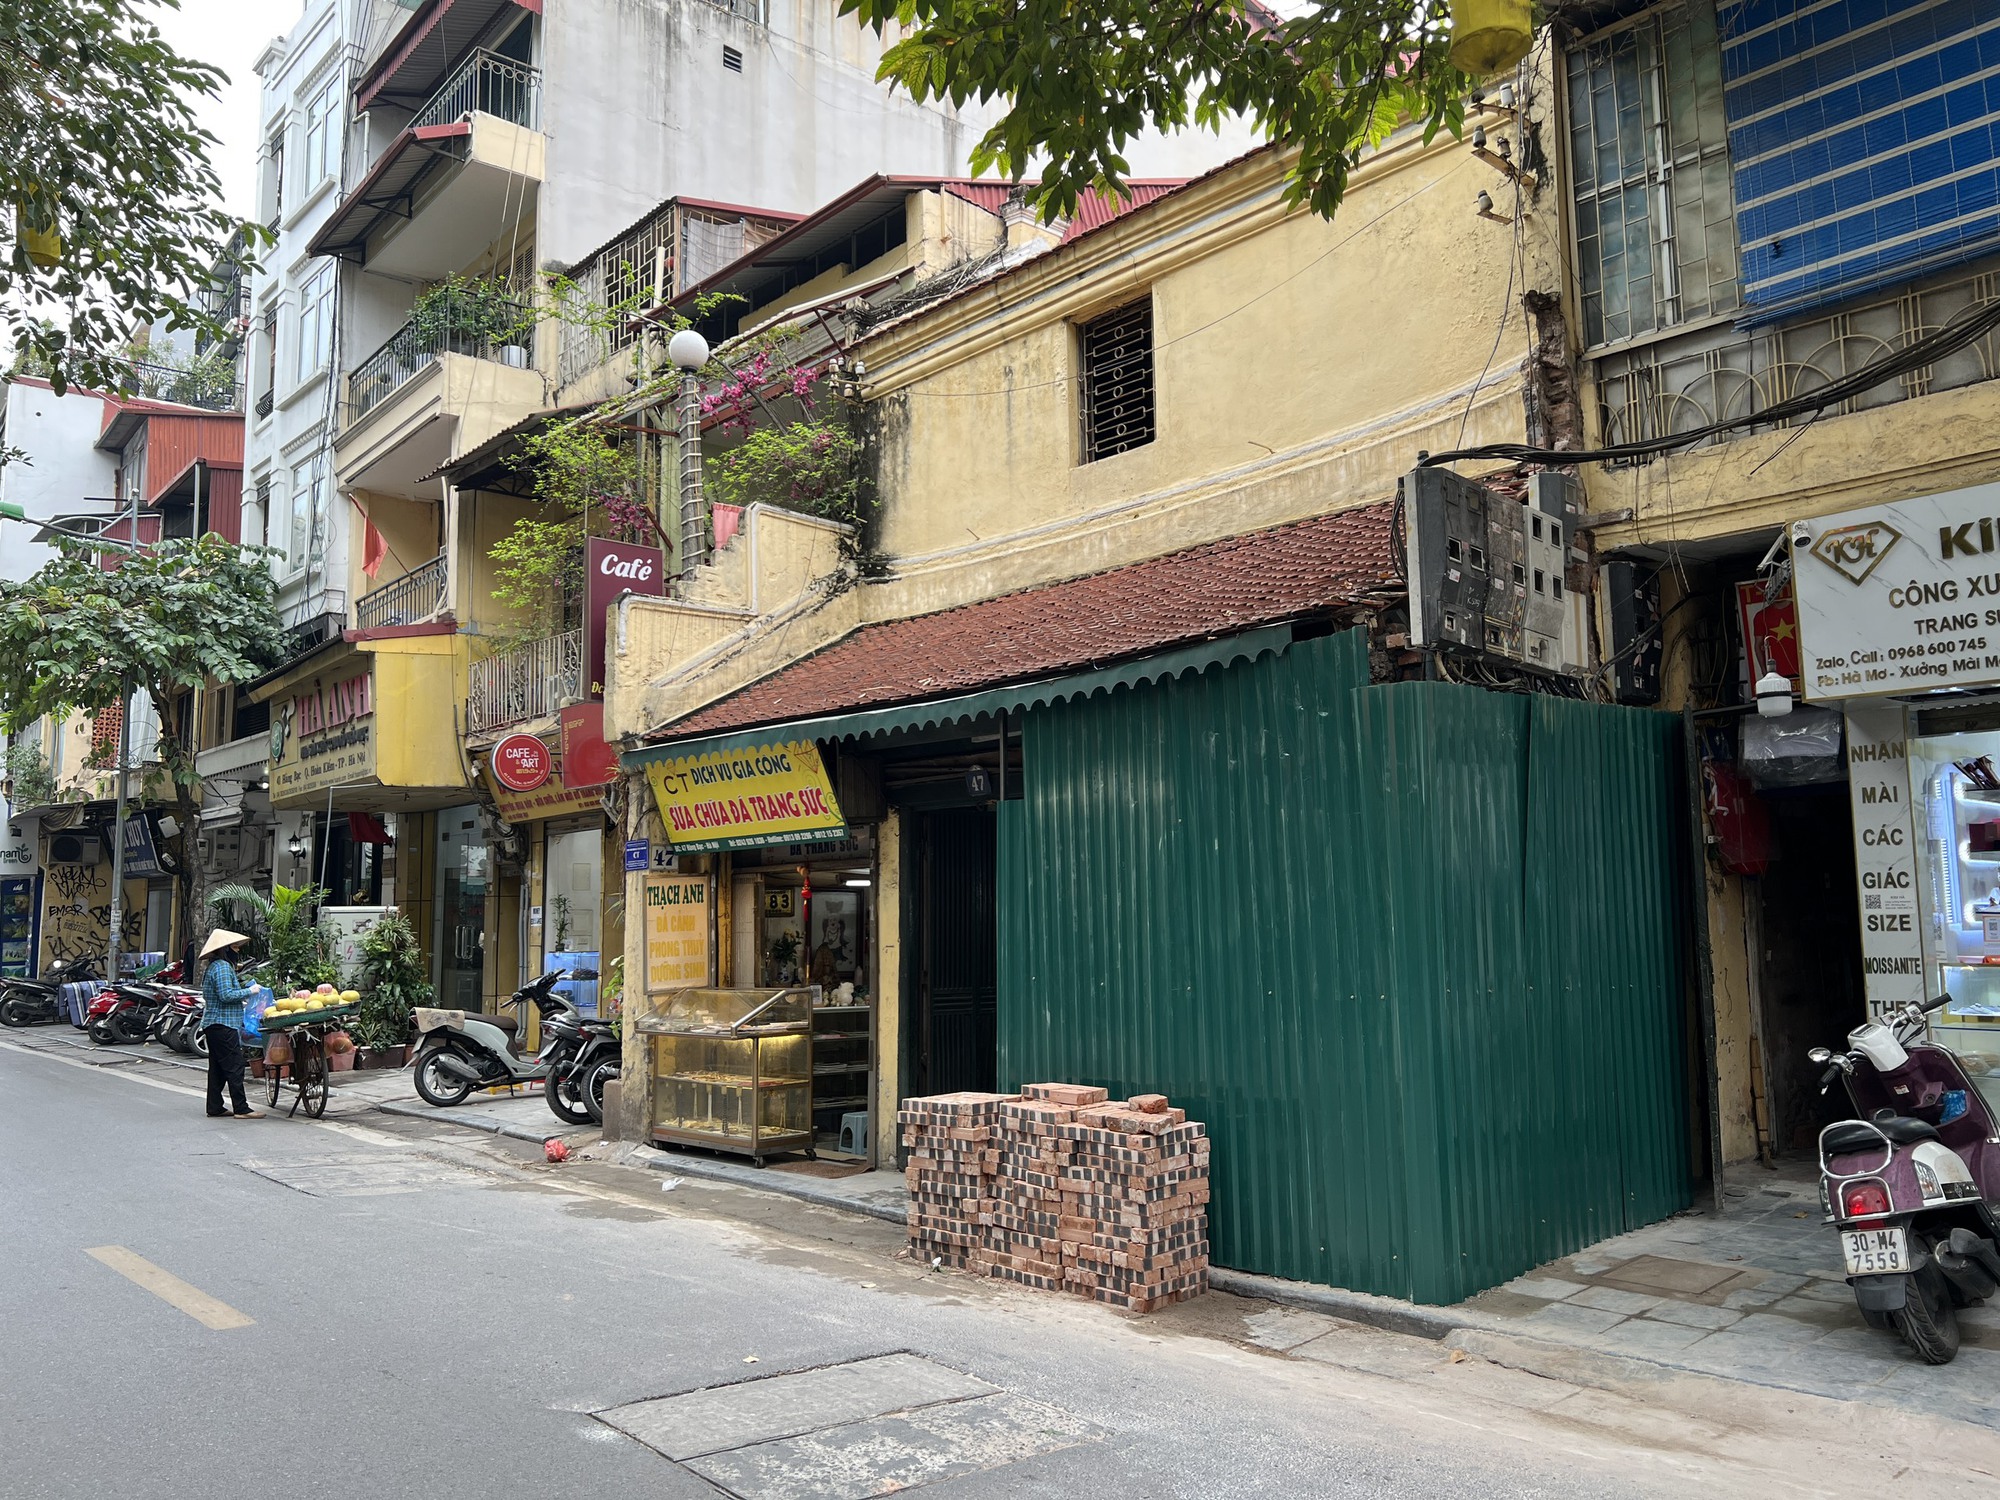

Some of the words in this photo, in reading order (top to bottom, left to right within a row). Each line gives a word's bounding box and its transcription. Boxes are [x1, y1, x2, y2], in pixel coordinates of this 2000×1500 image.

[601, 554, 652, 581] Café
[1888, 579, 1958, 609] CÔNG
[1914, 612, 1978, 635] TRANG
[1985, 609, 2000, 626] S
[1816, 656, 1849, 671] Zalo,
[1888, 644, 1925, 660] 0968
[1927, 641, 1956, 655] 600
[1958, 637, 1987, 652] 745
[1841, 670, 1861, 684] Hà
[1865, 668, 1887, 682] Mơ
[1900, 661, 1948, 679] Xưởng
[1953, 657, 1980, 672] Mài
[297, 679, 325, 738] HÀ
[326, 673, 371, 729] ANH
[506, 747, 530, 759] CAFE
[521, 758, 539, 768] ART
[1851, 741, 1905, 763] NHẬN
[690, 764, 717, 787] DỊCH
[717, 760, 732, 783] VỤ
[732, 758, 755, 780] GIA
[755, 753, 792, 776] CÔNG
[972, 775, 983, 791] 47
[1862, 781, 1898, 804] MÀI
[669, 800, 697, 831] SỬA
[694, 798, 731, 829] CHỮA
[730, 794, 753, 825] ĐÁ
[749, 791, 801, 822] TRANG
[1862, 825, 1903, 846] CÁC
[653, 849, 675, 866] 47
[1862, 867, 1910, 889] GIÁC
[647, 885, 680, 910] THẠCH
[682, 884, 704, 904] ANH
[656, 912, 669, 933] ĐÁ
[670, 910, 696, 933] CẢNH
[1867, 914, 1912, 932] SIZE
[649, 941, 680, 959] PHONG
[684, 962, 705, 979] SINH
[1865, 957, 1921, 975] MOISSANITE
[1853, 1252, 1899, 1273] 7559
